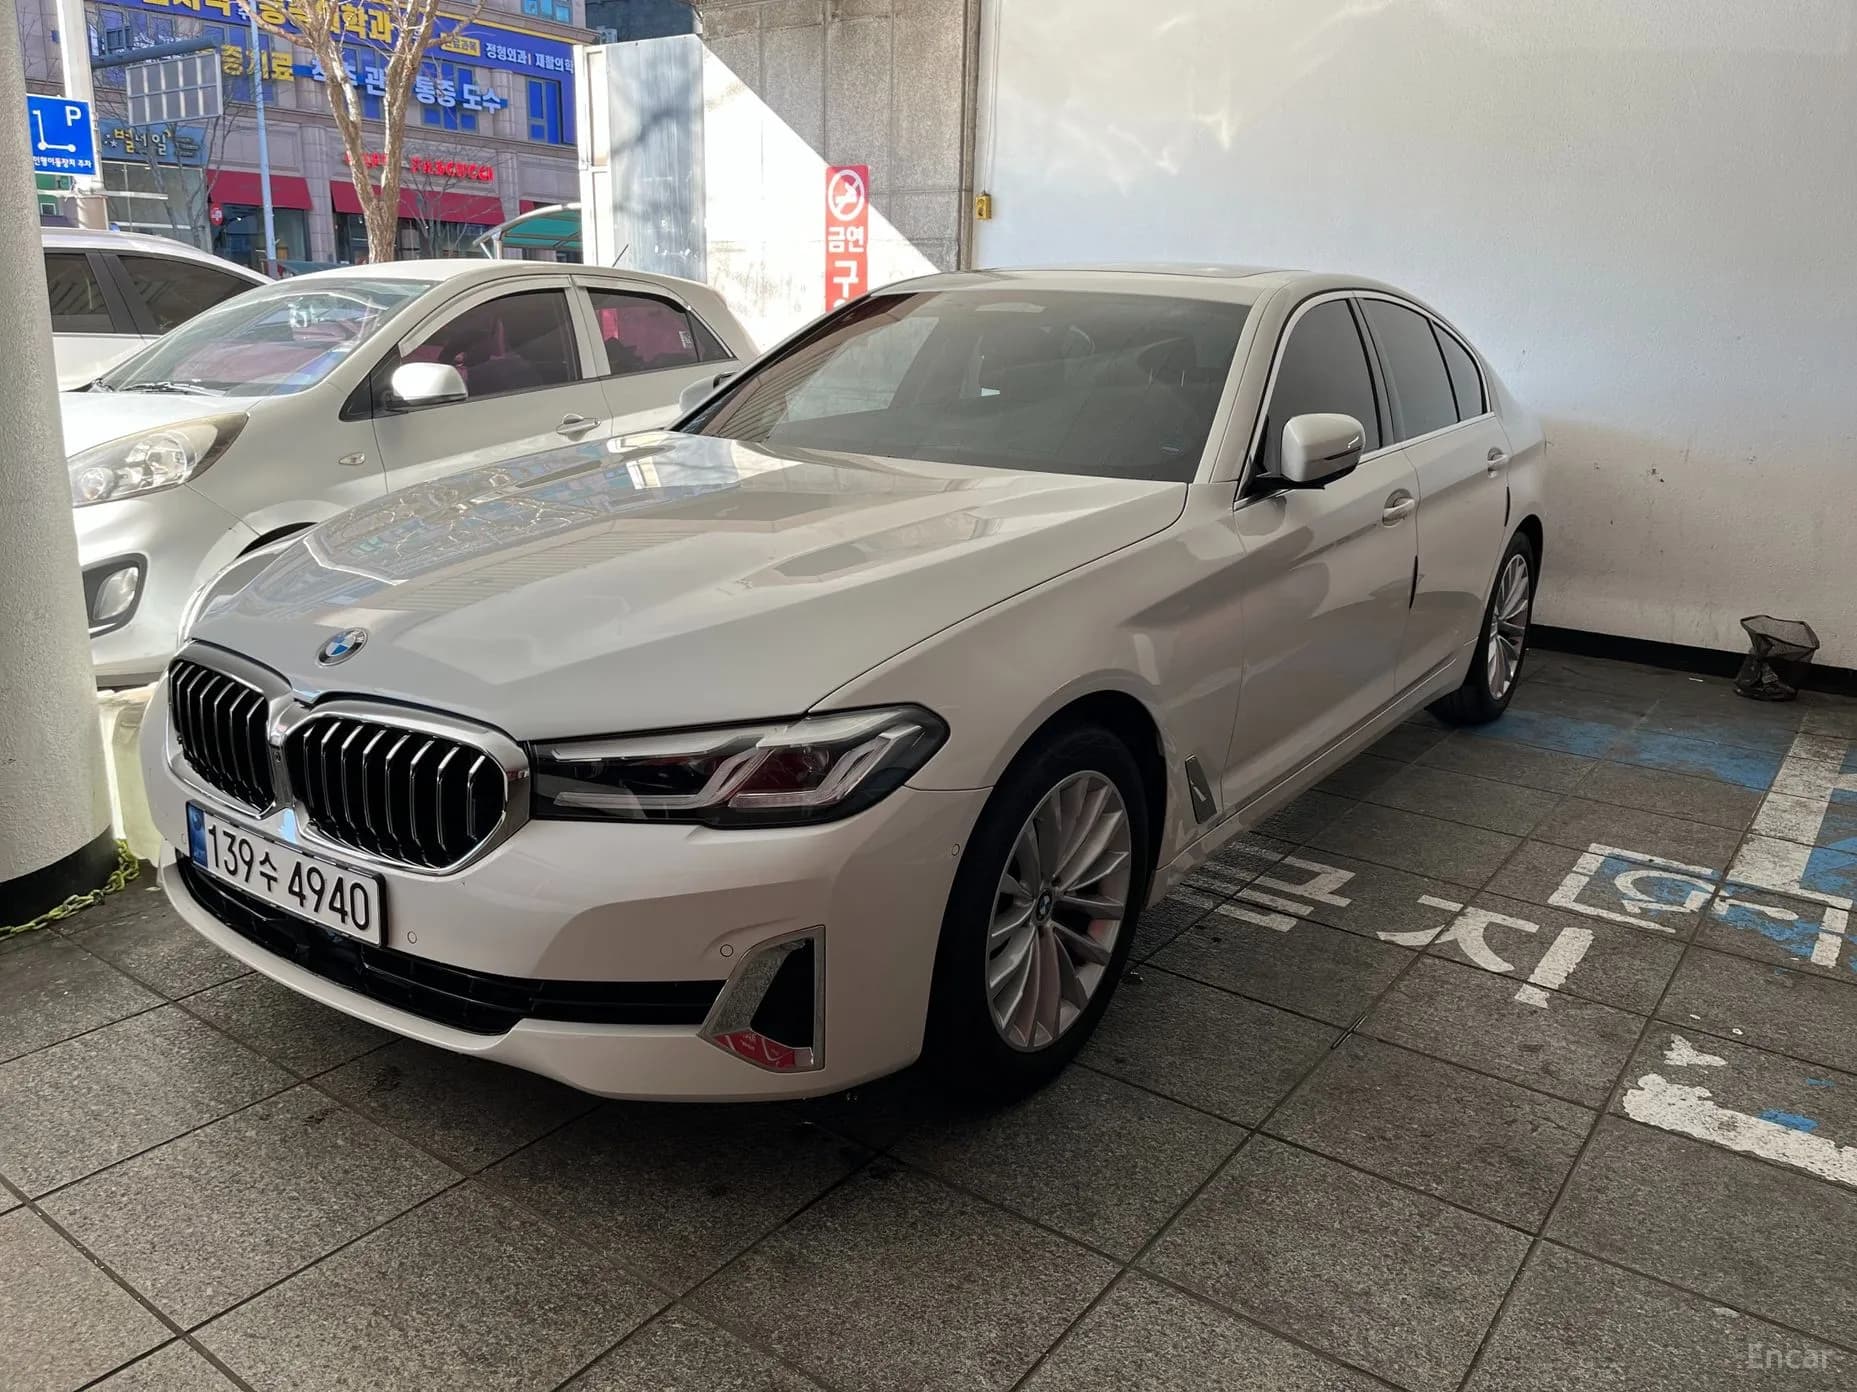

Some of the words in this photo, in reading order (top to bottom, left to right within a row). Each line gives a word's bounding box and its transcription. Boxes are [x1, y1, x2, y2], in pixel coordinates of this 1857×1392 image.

[485, 43, 527, 65] 정형외과
[365, 66, 387, 97] 관
[415, 76, 456, 107] 통증
[463, 84, 501, 114] 도수
[64, 106, 82, 127] P
[827, 226, 865, 253] 금연
[833, 260, 860, 308] 구
[208, 823, 279, 893] 139수
[287, 860, 371, 931] 4940
